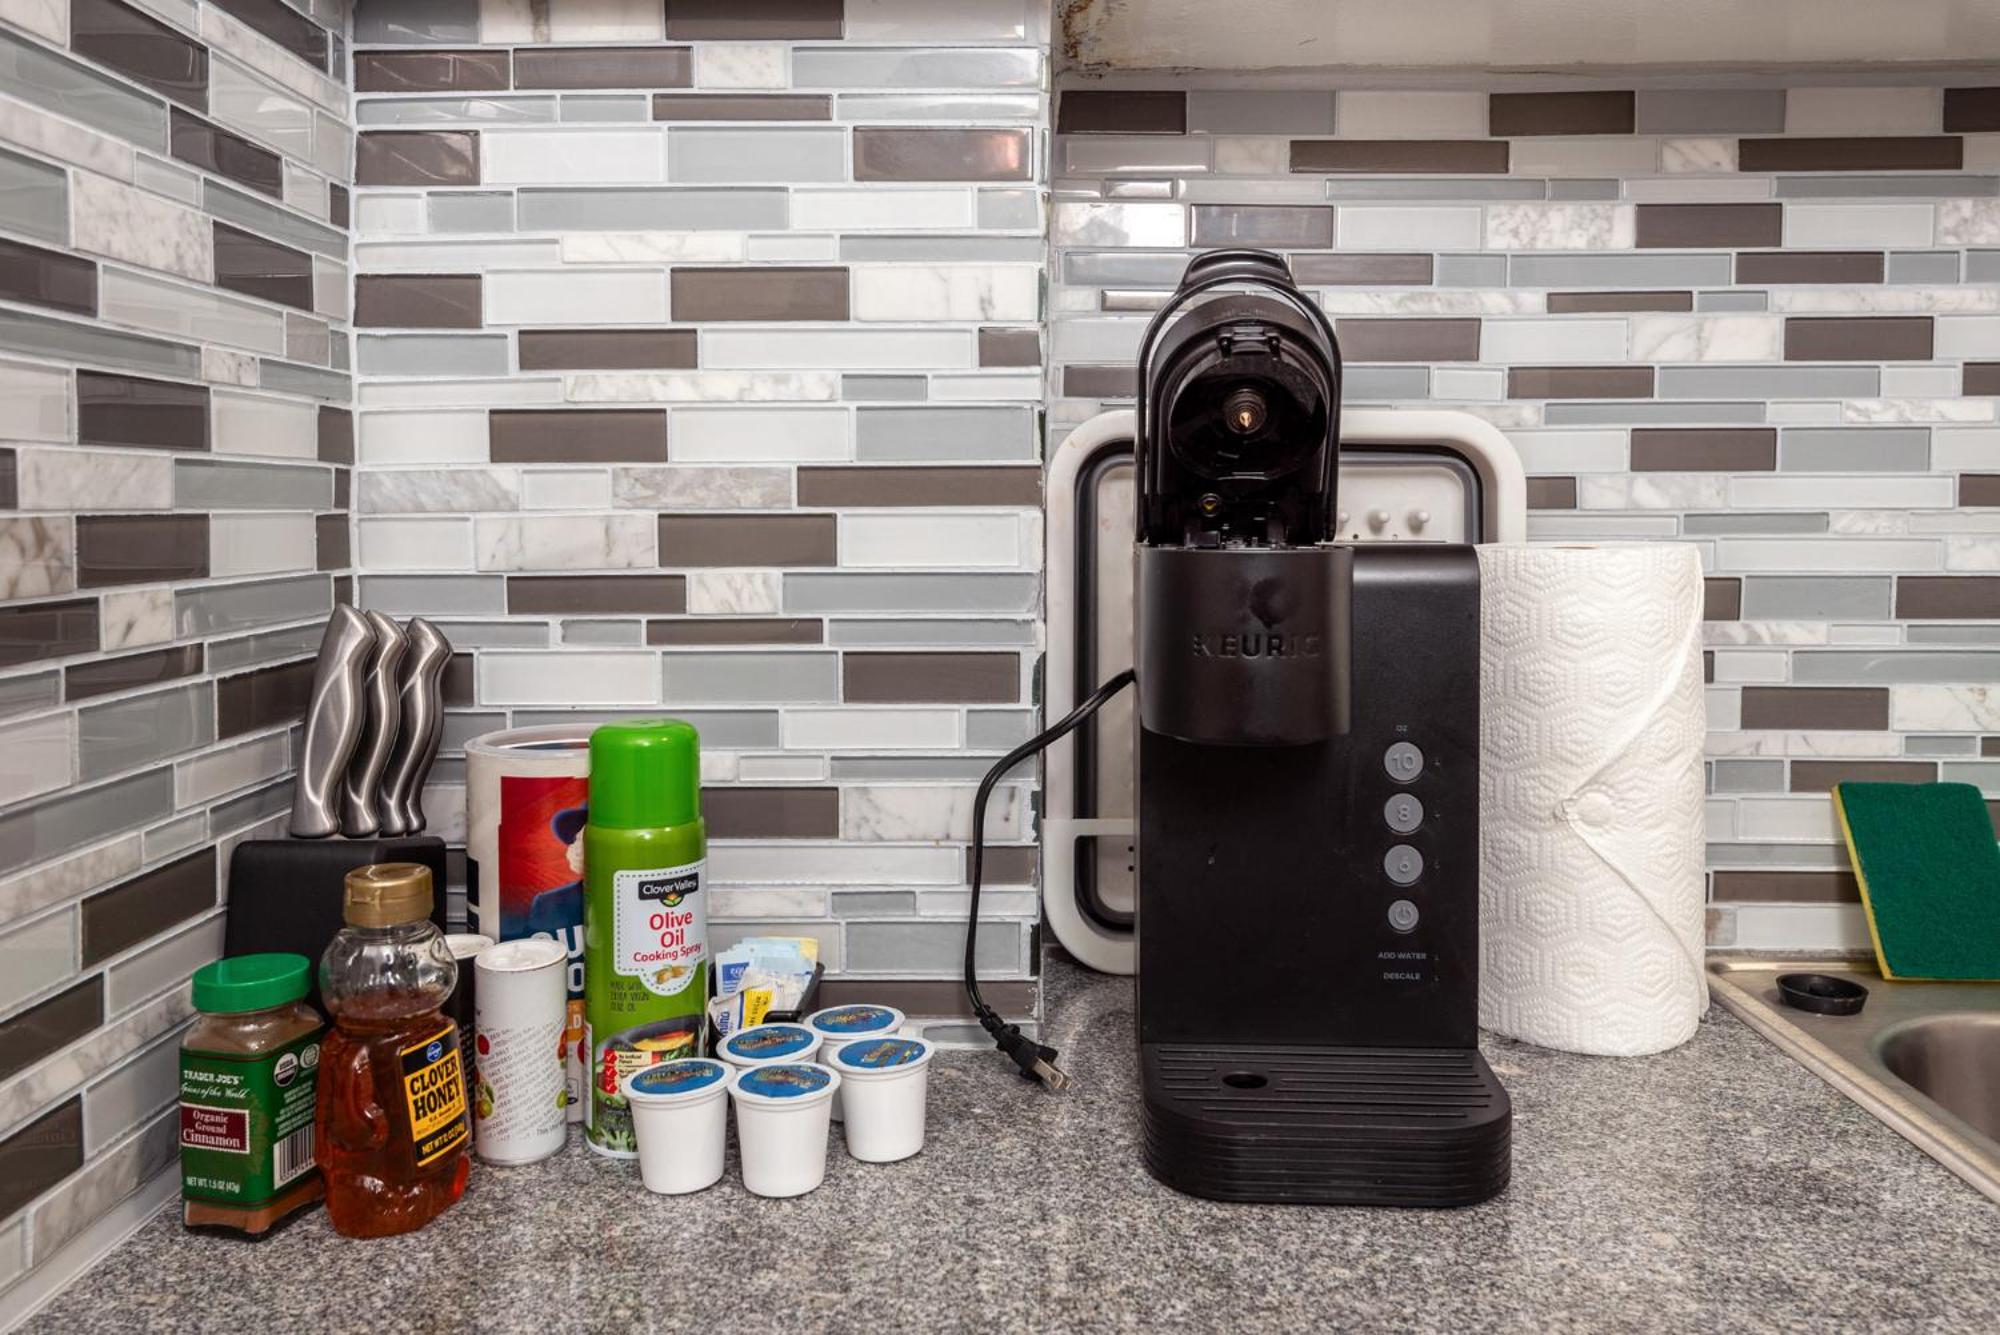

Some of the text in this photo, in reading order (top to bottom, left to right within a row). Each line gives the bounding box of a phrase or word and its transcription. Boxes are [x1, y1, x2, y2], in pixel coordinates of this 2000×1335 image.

[1391, 754, 1415, 770] 10
[1398, 803, 1410, 821] 8
[1398, 855, 1410, 873] 6
[643, 884, 674, 894] Clover
[649, 911, 693, 930] Olive
[660, 928, 684, 947] Oil
[633, 943, 702, 962] Cooking Spray
[1383, 972, 1420, 980] DESCALE
[183, 1070, 240, 1085] TRADER JOE'S
[410, 1056, 459, 1096] CLOVER
[413, 1074, 461, 1121] HONEY
[193, 1110, 229, 1124] Organic
[195, 1121, 227, 1135] Ground
[183, 1128, 240, 1148] Cinnamon
